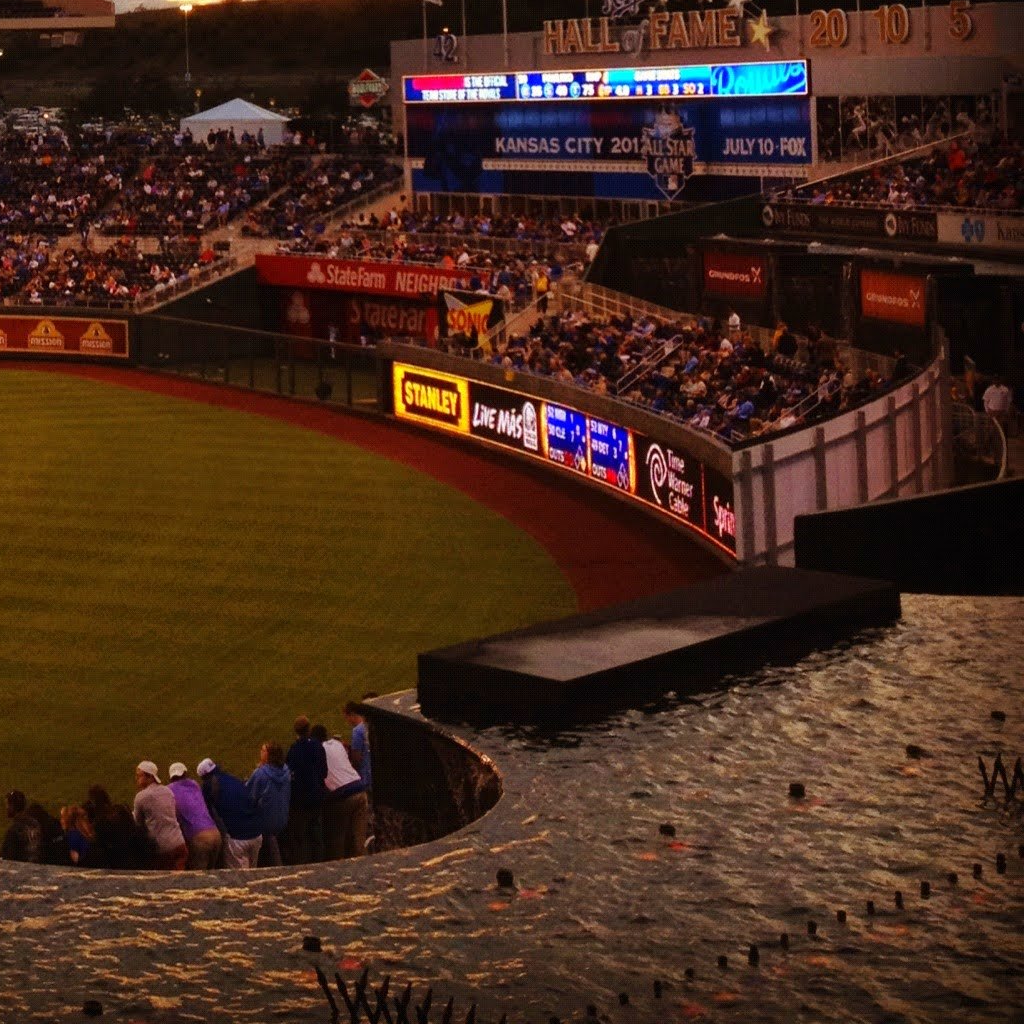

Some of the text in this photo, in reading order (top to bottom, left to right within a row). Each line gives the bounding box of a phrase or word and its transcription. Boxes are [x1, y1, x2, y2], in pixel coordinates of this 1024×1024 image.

[810, 8, 848, 48] 20
[874, 3, 909, 44] 10
[949, 0, 972, 41] 5
[543, 8, 741, 60] HALL of FAME
[495, 136, 560, 154] KANSAS
[565, 136, 604, 154] CITY
[643, 138, 694, 156] ALL STAR
[723, 137, 754, 156] JULY
[780, 138, 807, 157] FOX
[654, 156, 686, 173] GAME
[326, 263, 386, 289] StateFarm
[30, 337, 63, 347] mission
[82, 339, 111, 350] mission
[404, 380, 459, 416] STANLEY
[549, 446, 565, 463] OUTS
[598, 440, 610, 456] DET
[592, 462, 607, 479] OUTS
[667, 448, 685, 474] Time
[668, 470, 694, 498] Warner
[669, 491, 689, 517] Cable
